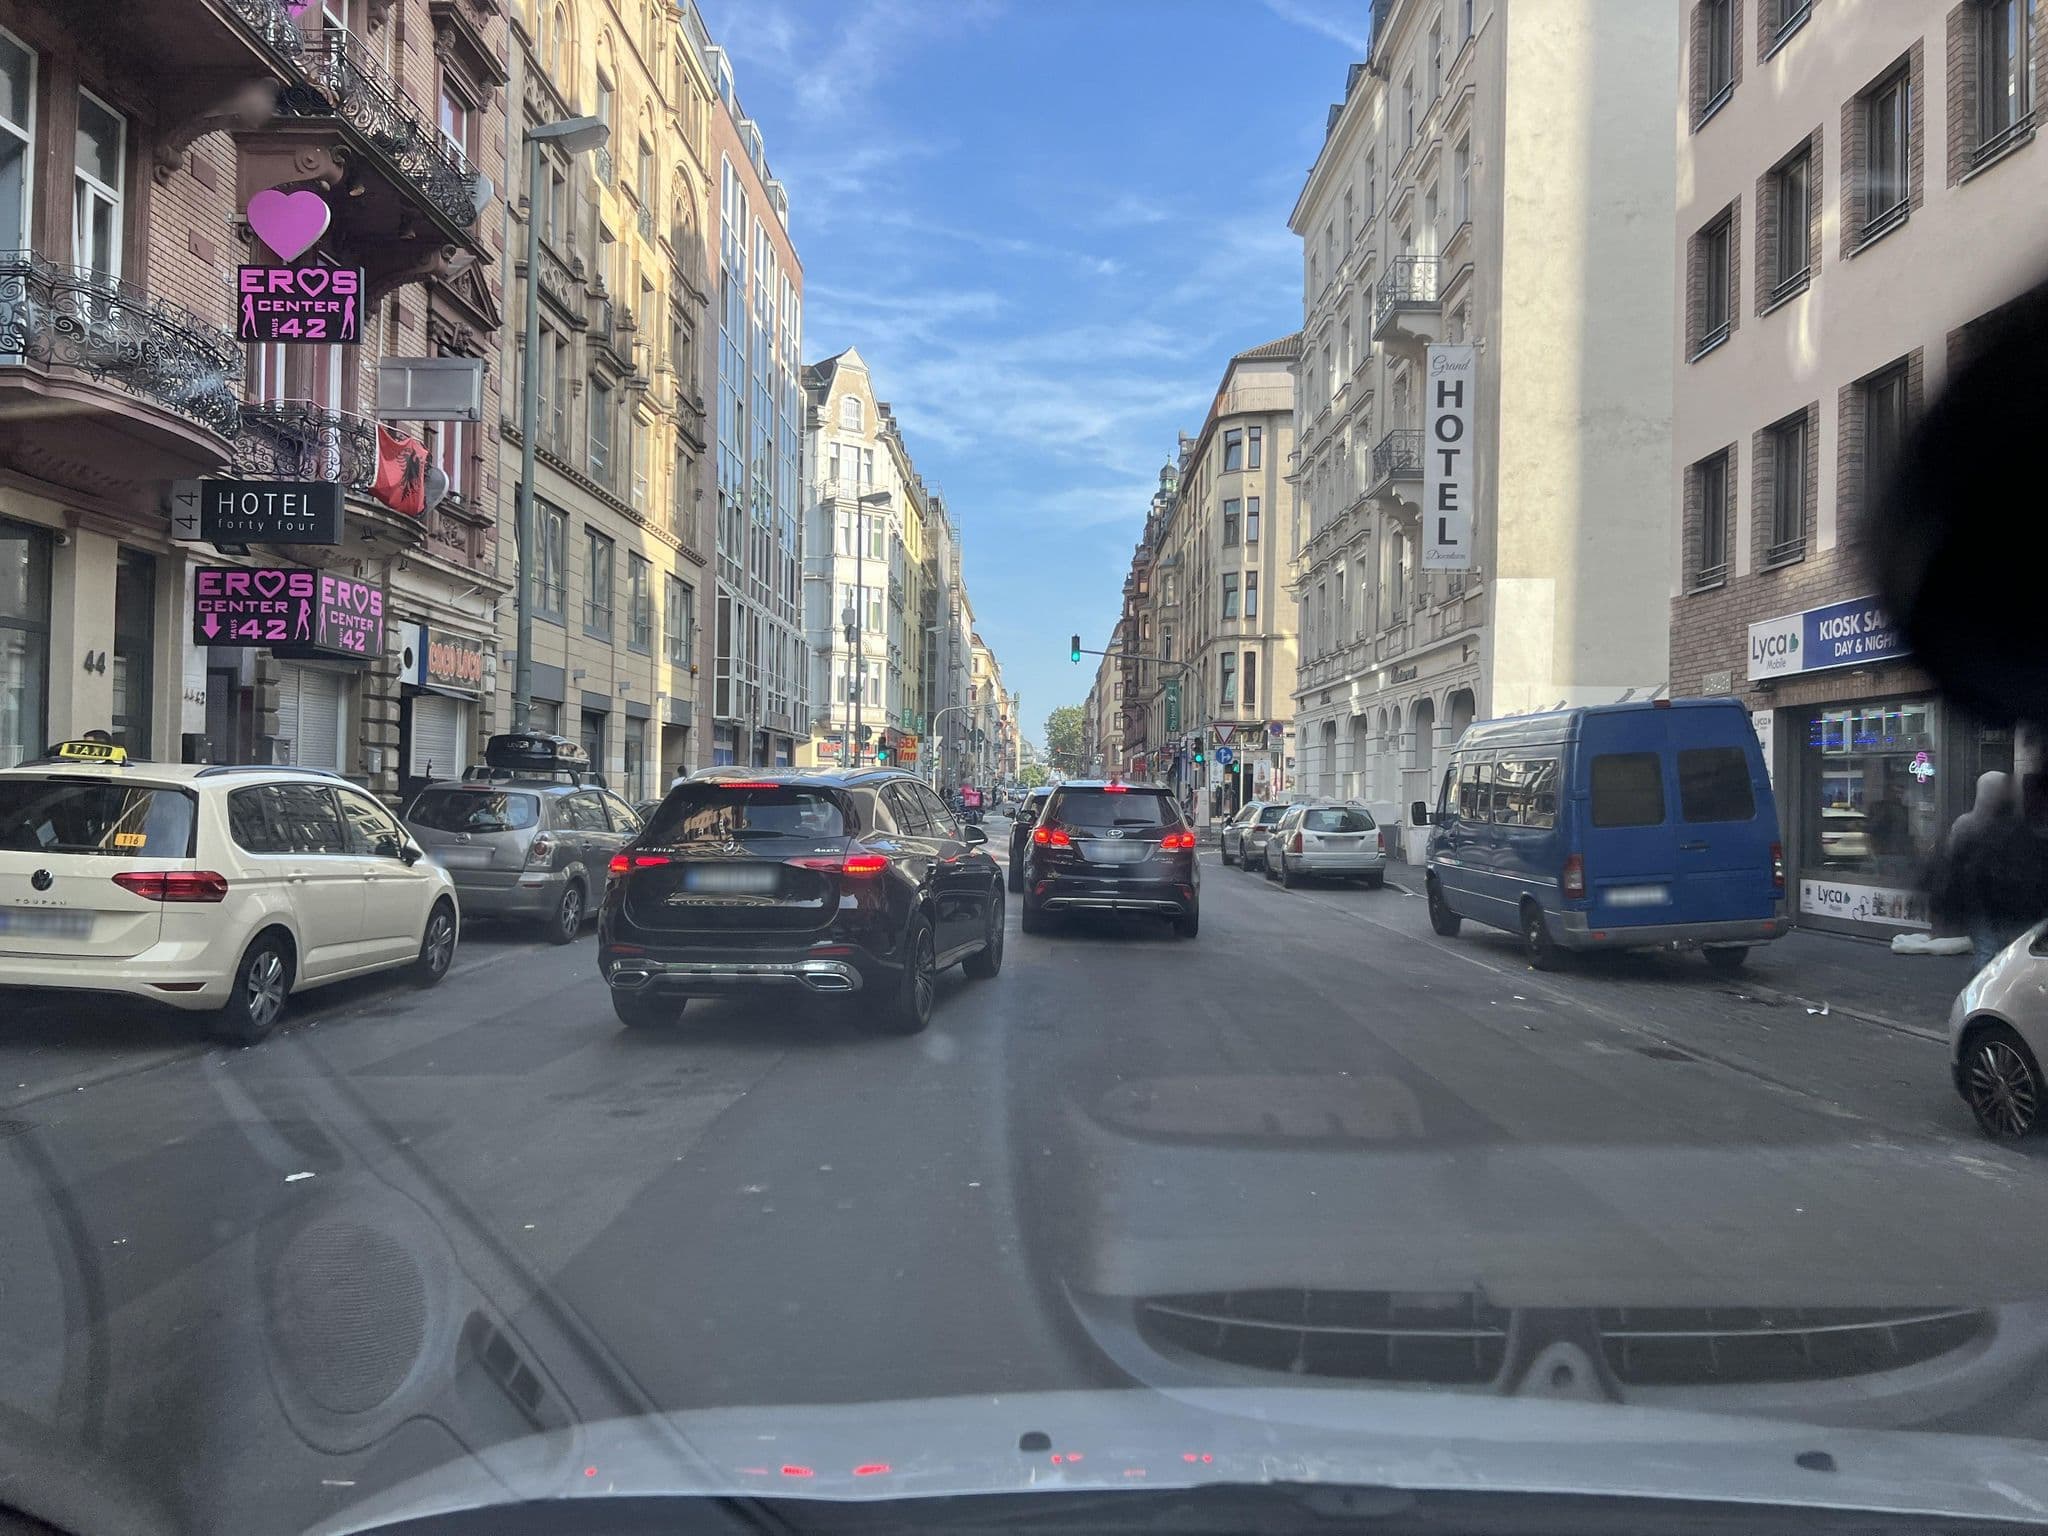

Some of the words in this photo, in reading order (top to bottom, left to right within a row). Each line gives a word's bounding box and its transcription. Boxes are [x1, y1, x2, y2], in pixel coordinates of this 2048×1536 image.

[258, 300, 340, 313] CENTER
[271, 318, 279, 338] HAUS
[279, 318, 327, 338] 42
[1430, 354, 1471, 377] Grand
[1434, 380, 1464, 545] HOTEL
[218, 492, 315, 517] HOTEL
[218, 519, 265, 532] forty
[277, 520, 315, 531] four
[198, 600, 289, 614] CENTER
[238, 619, 288, 640] 42
[330, 610, 374, 632] CENTER
[1819, 612, 1861, 642] KIOSK
[343, 629, 366, 652] 42
[1752, 632, 1787, 664] Lyca
[1834, 640, 1853, 657] DAY
[1854, 639, 1863, 653] &
[83, 650, 106, 676] 44
[1766, 658, 1787, 670] Mobile
[73, 744, 108, 757] TAXI
[1908, 759, 1936, 777] Coffee
[1817, 885, 1843, 905] Lyca
